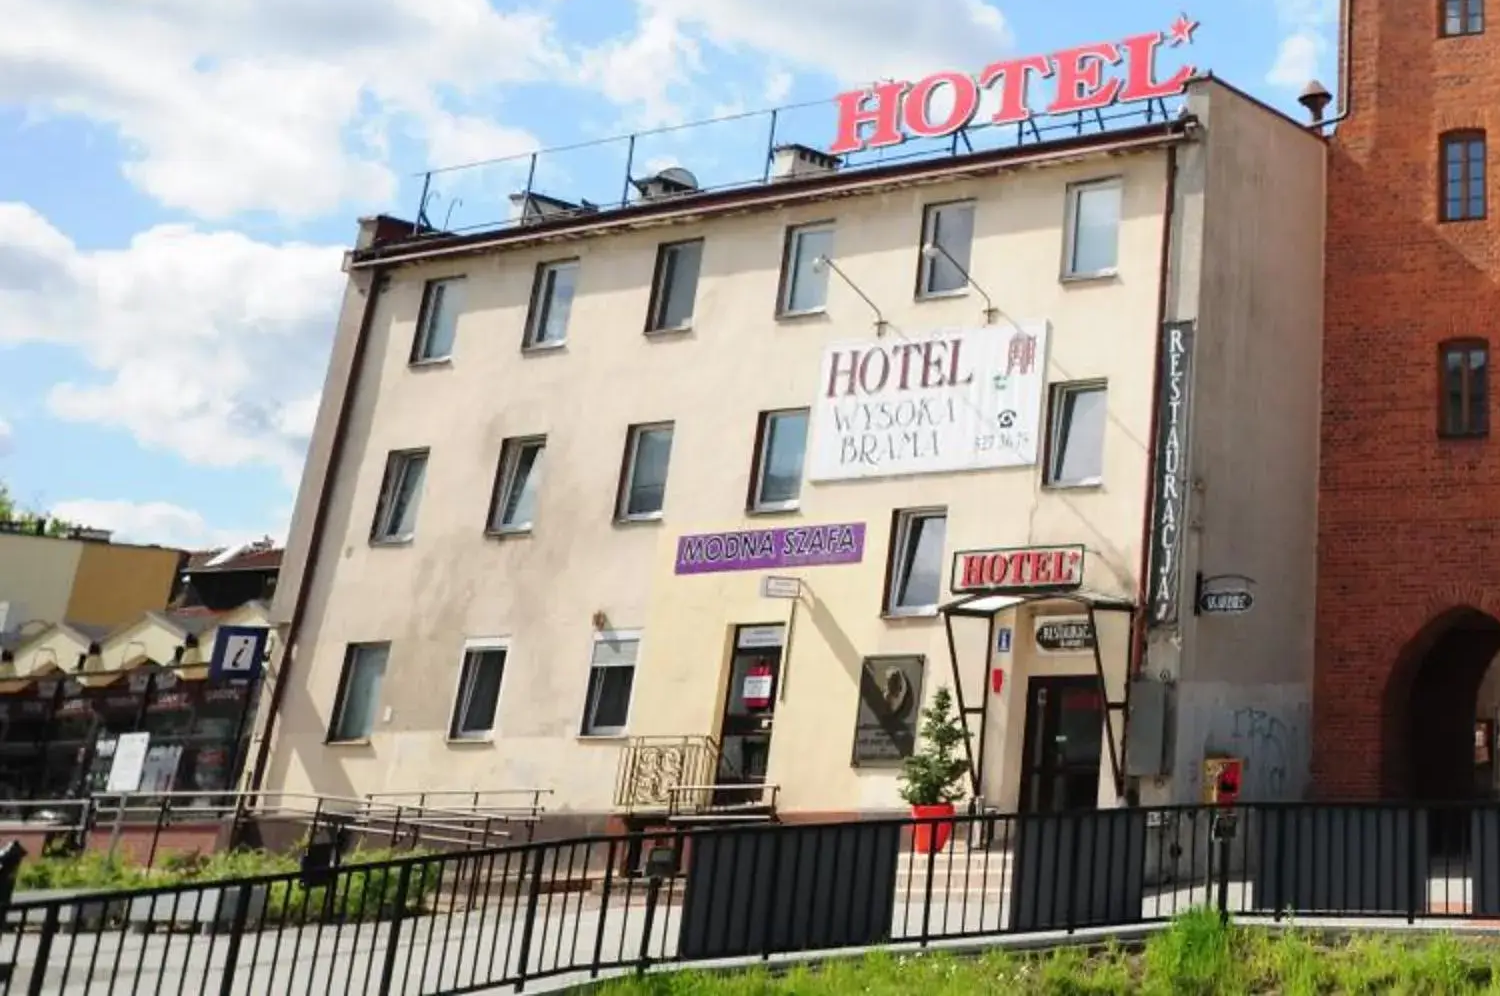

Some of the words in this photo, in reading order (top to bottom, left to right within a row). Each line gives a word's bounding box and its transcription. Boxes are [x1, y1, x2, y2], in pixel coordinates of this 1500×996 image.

[830, 31, 1196, 154] HOTEL
[826, 338, 974, 400] HOTEL
[1155, 329, 1185, 601] RESTAURACJA
[681, 531, 777, 565] MODNA
[782, 524, 857, 556] SZAFA
[960, 550, 1073, 587] HOTEL
